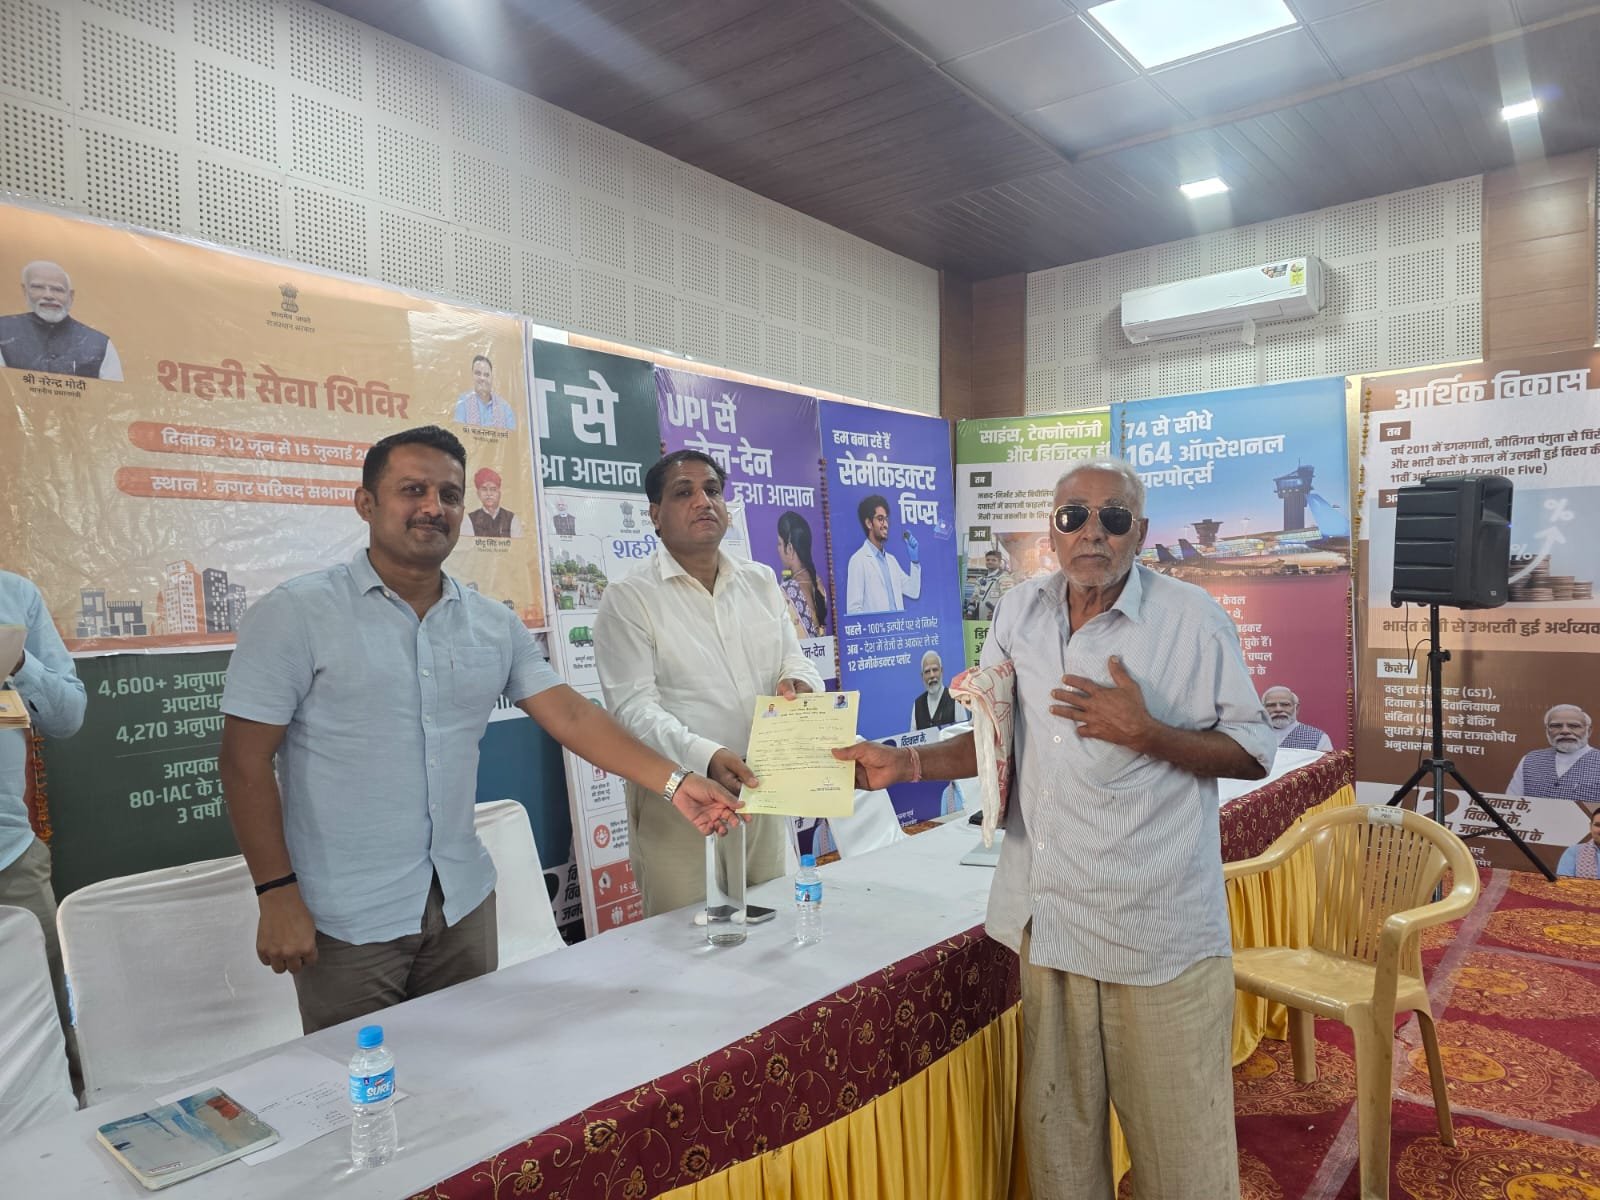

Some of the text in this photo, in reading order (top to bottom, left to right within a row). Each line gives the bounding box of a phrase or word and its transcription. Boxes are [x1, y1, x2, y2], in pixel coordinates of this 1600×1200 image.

[23, 373, 35, 385] श्री
[65, 378, 86, 391] मोदी
[157, 359, 410, 420] शहरी सेवा शिविर
[1394, 368, 1591, 409] आर्थिक विकास
[563, 369, 619, 446] से
[666, 392, 737, 434] UPI से
[1027, 419, 1103, 441] टेक्नोलॉजी
[1125, 409, 1214, 440] 74 से सीधे
[161, 426, 217, 449] दिनांक
[228, 437, 245, 451] 12
[247, 440, 275, 458] जून
[277, 439, 292, 455] से
[294, 443, 309, 456] 15
[313, 444, 353, 462] जुलाई
[832, 429, 892, 449] हम बना रहे हैं
[1126, 441, 1173, 467] 164
[1178, 434, 1286, 462] ऑपरेशनल
[1390, 444, 1404, 455] वर्ष
[1407, 444, 1429, 455] 2011
[1432, 441, 1443, 452] में
[1495, 434, 1535, 447] नीतिगत
[1538, 432, 1564, 446] पंगुता
[1567, 429, 1578, 442] से
[1581, 428, 1600, 441] घिर
[684, 432, 773, 478] ेन-देन
[1006, 445, 1033, 462] और
[1036, 442, 1093, 462] डिजिटल
[1391, 458, 1409, 469] और
[1412, 456, 1434, 467] भारी
[1437, 454, 1458, 466] करों
[1458, 453, 1469, 464] के
[1471, 453, 1494, 463] जाल
[1496, 450, 1509, 461] में
[1509, 447, 1541, 461] उलझी
[1543, 446, 1558, 461] हुई
[1561, 445, 1587, 457] विश्व
[571, 456, 643, 487] आसान
[836, 450, 937, 490] सेमीकंडक्टर
[1137, 461, 1214, 490] यरपोर्ट्स
[1391, 471, 1412, 483] 11वीं
[1518, 462, 1548, 475] Five)
[150, 475, 355, 501] स्थान नगर परिषद सभागा
[767, 484, 815, 508] आसान
[898, 491, 939, 525] चिप्स
[613, 534, 658, 559] शहरी
[1223, 594, 1246, 606] केवल
[845, 622, 862, 636] पहले
[868, 623, 886, 635] 100%
[1383, 617, 1600, 637] भारत तेी से उभरती हुई अर्थव्यव
[847, 644, 859, 655] अब
[864, 640, 876, 653] देश
[897, 637, 904, 650] से
[1245, 637, 1259, 650] चुके
[848, 661, 857, 672] 12
[1248, 651, 1272, 662] चप्पल
[1257, 663, 1267, 675] के
[98, 671, 228, 699] 4,600+ अनुपा
[1384, 685, 1404, 696] वस्तु
[1405, 684, 1419, 695] एवं
[1442, 687, 1459, 697] कर
[162, 693, 224, 714] अपराध
[1384, 697, 1416, 708] दिवाला
[116, 715, 225, 744] 4,270 अनुपा
[1384, 725, 1414, 737] सुधारों
[1464, 731, 1518, 743] राजकोषीय
[1384, 739, 1433, 752] अनुशासन
[129, 783, 192, 810] 80-IAC
[195, 777, 214, 796] के
[177, 807, 188, 824] 3
